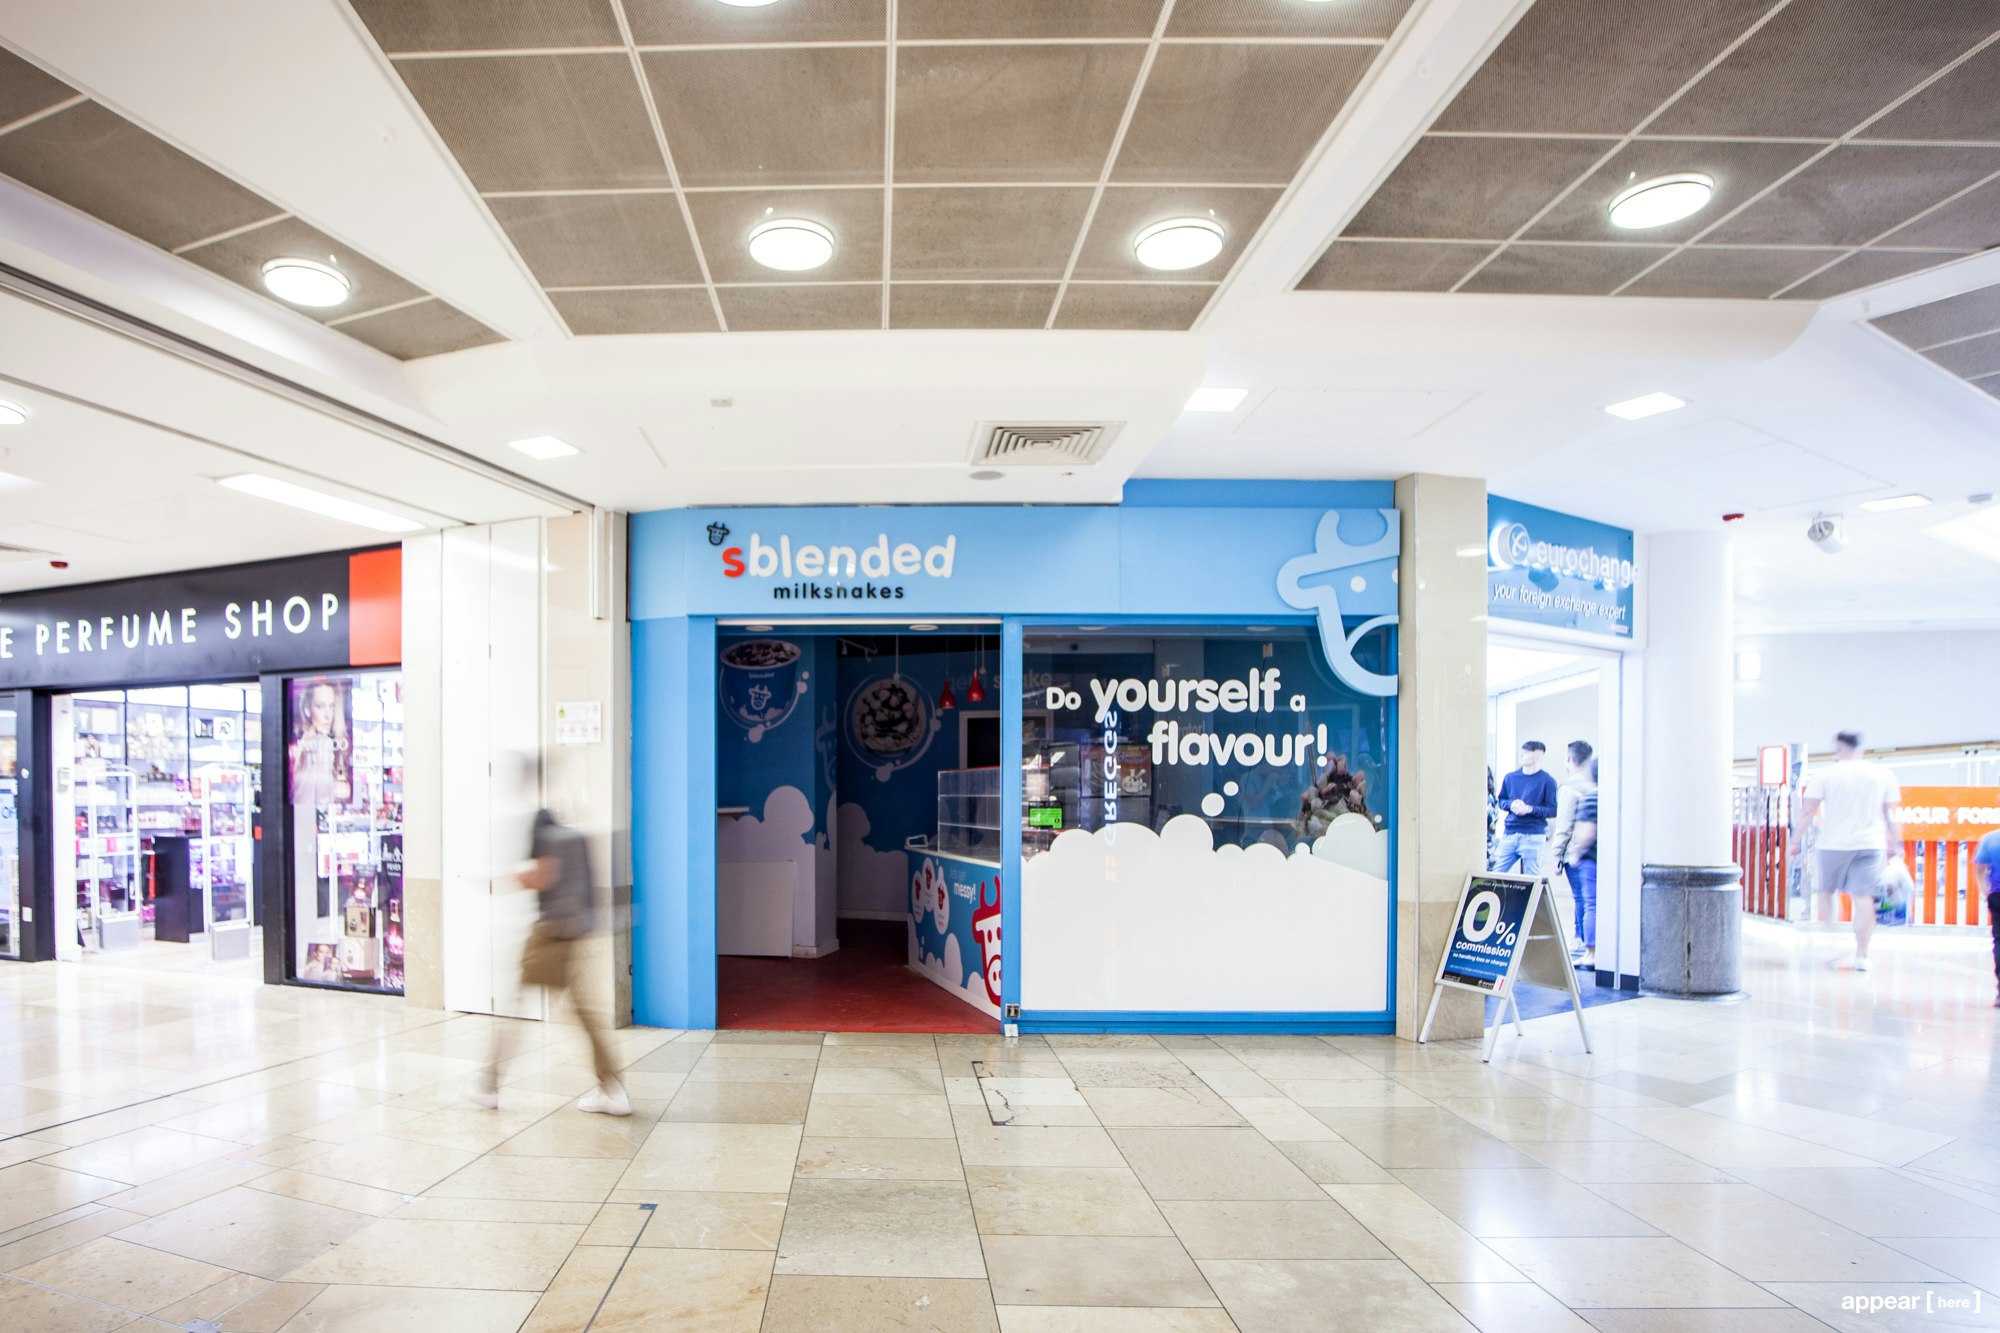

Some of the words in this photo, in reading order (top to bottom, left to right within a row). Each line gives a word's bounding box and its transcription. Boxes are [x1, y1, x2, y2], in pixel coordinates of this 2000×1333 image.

[722, 533, 957, 579] sblended
[1536, 540, 1641, 588] eurochange
[773, 582, 905, 600] milkshakes
[1493, 583, 1516, 600] your
[1519, 585, 1552, 610] foreign
[1554, 594, 1596, 617] exchange
[1598, 604, 1627, 620] expert
[36, 607, 197, 656] PERFUME
[224, 592, 339, 640] SHOP
[1046, 687, 1082, 711] Do
[1090, 668, 1281, 724] yourself
[1290, 694, 1306, 712] a
[1147, 720, 1328, 767] flavour!
[1455, 941, 1511, 958] commission
